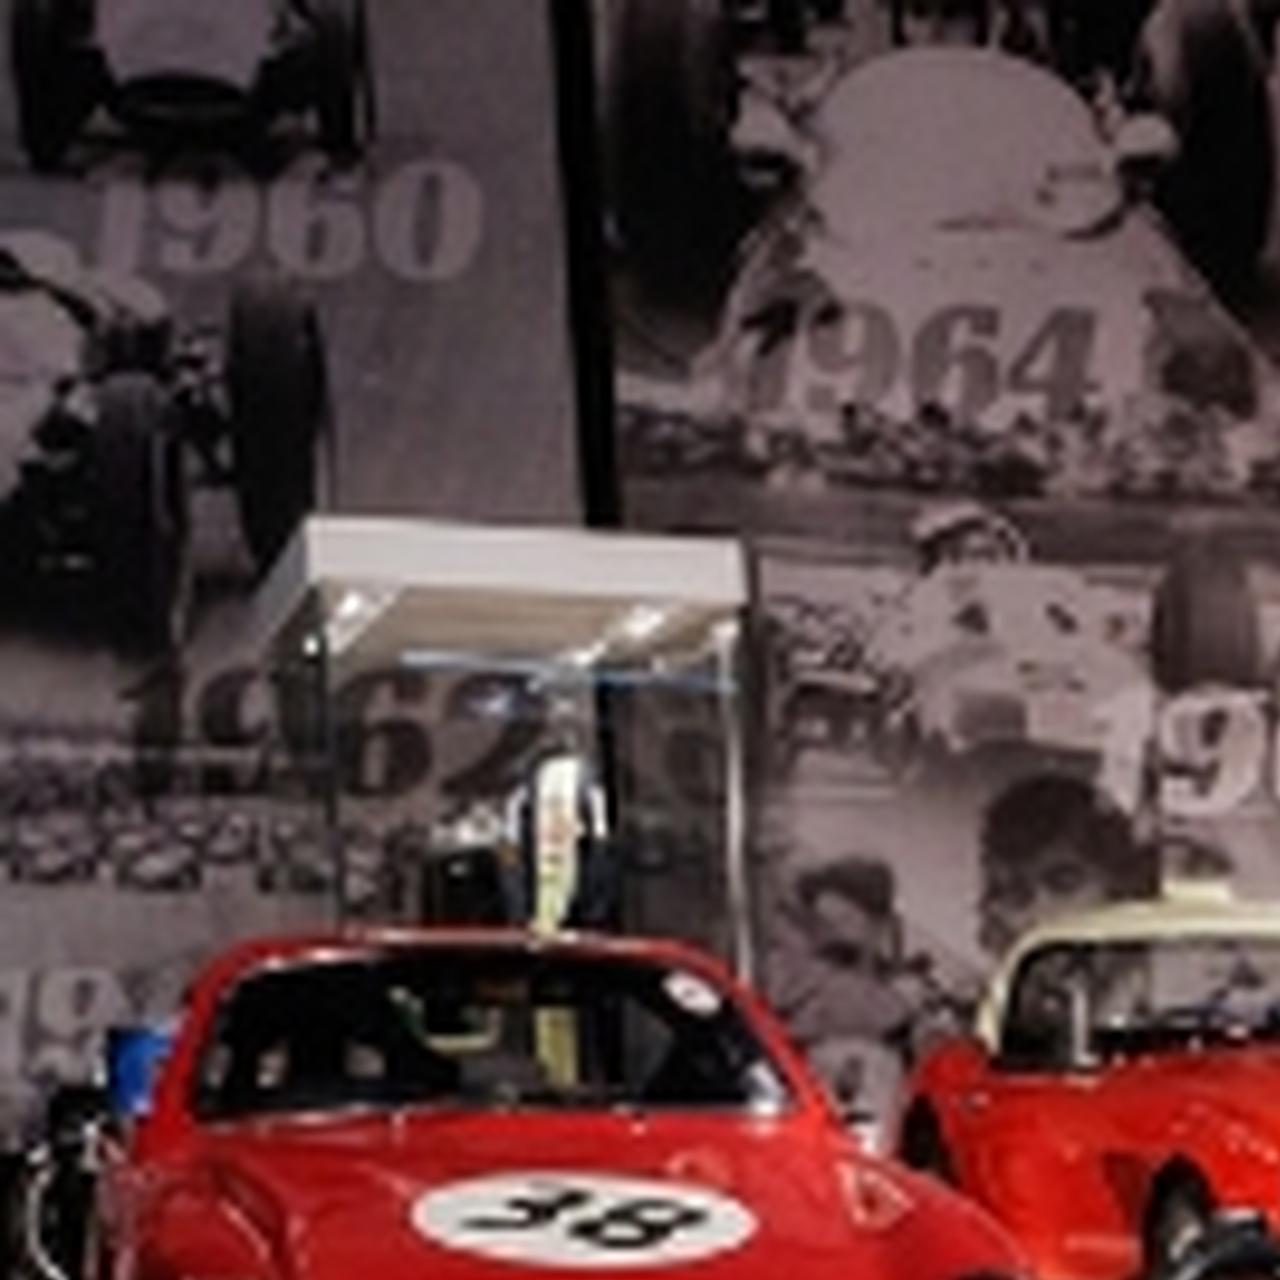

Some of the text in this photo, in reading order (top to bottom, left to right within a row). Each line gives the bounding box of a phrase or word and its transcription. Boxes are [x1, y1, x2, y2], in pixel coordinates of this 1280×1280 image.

[88, 153, 483, 282] 1960
[742, 302, 1102, 424] 1964
[460, 1183, 707, 1249] 38
